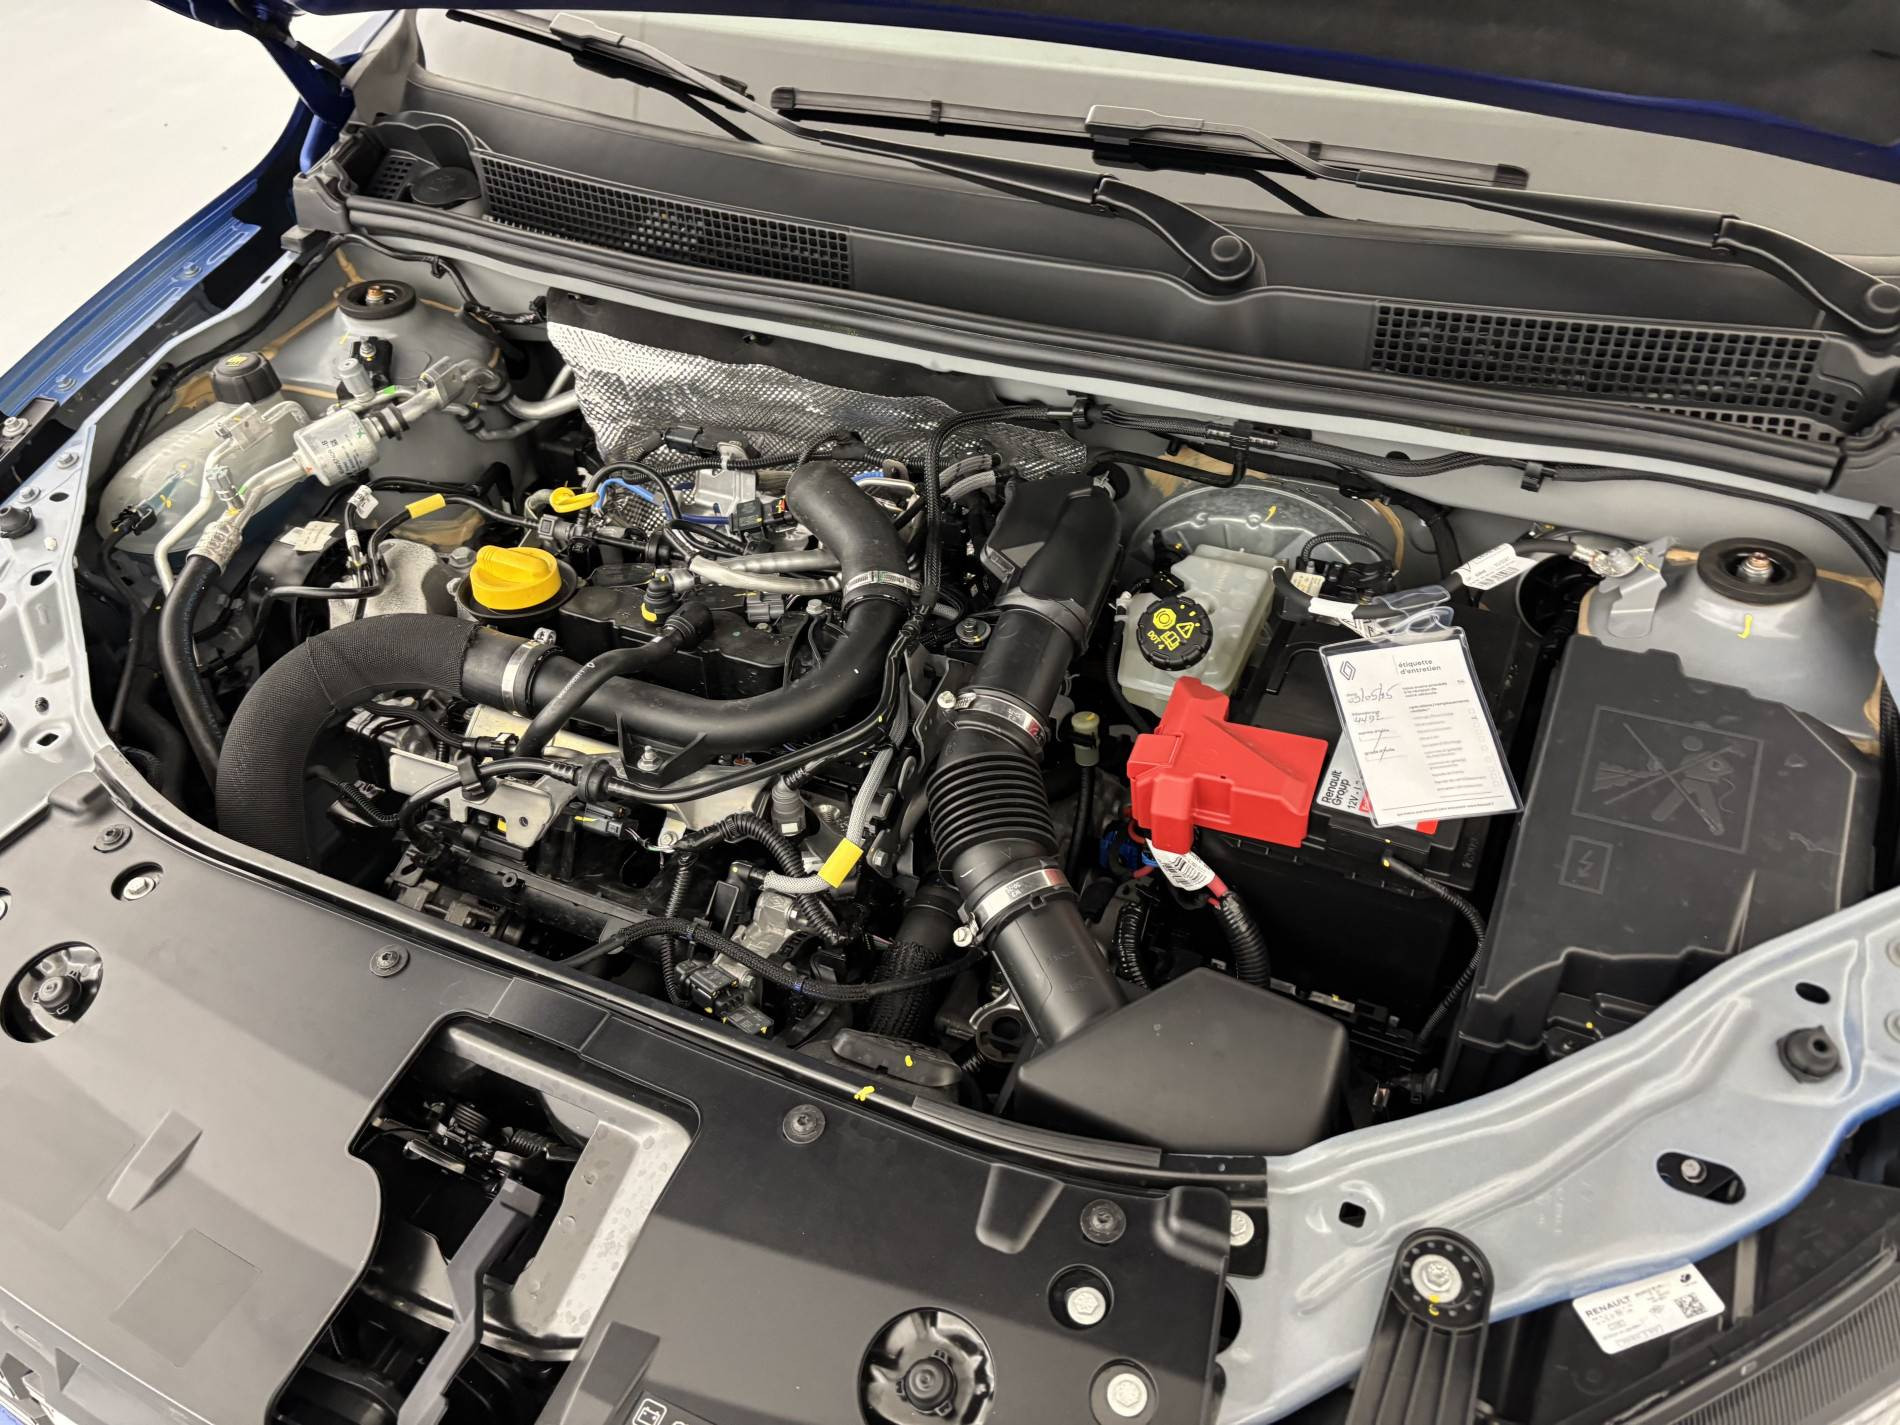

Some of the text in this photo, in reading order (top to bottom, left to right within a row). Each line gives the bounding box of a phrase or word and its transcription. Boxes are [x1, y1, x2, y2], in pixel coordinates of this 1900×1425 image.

[1147, 630, 1161, 644] DOT
[1398, 659, 1433, 669] étiquette
[1400, 665, 1442, 675] d'entretien
[1321, 770, 1342, 804] Renault
[1332, 778, 1351, 806] Group
[1347, 795, 1359, 810] 12V
[1584, 1295, 1631, 1318] RENAULT
